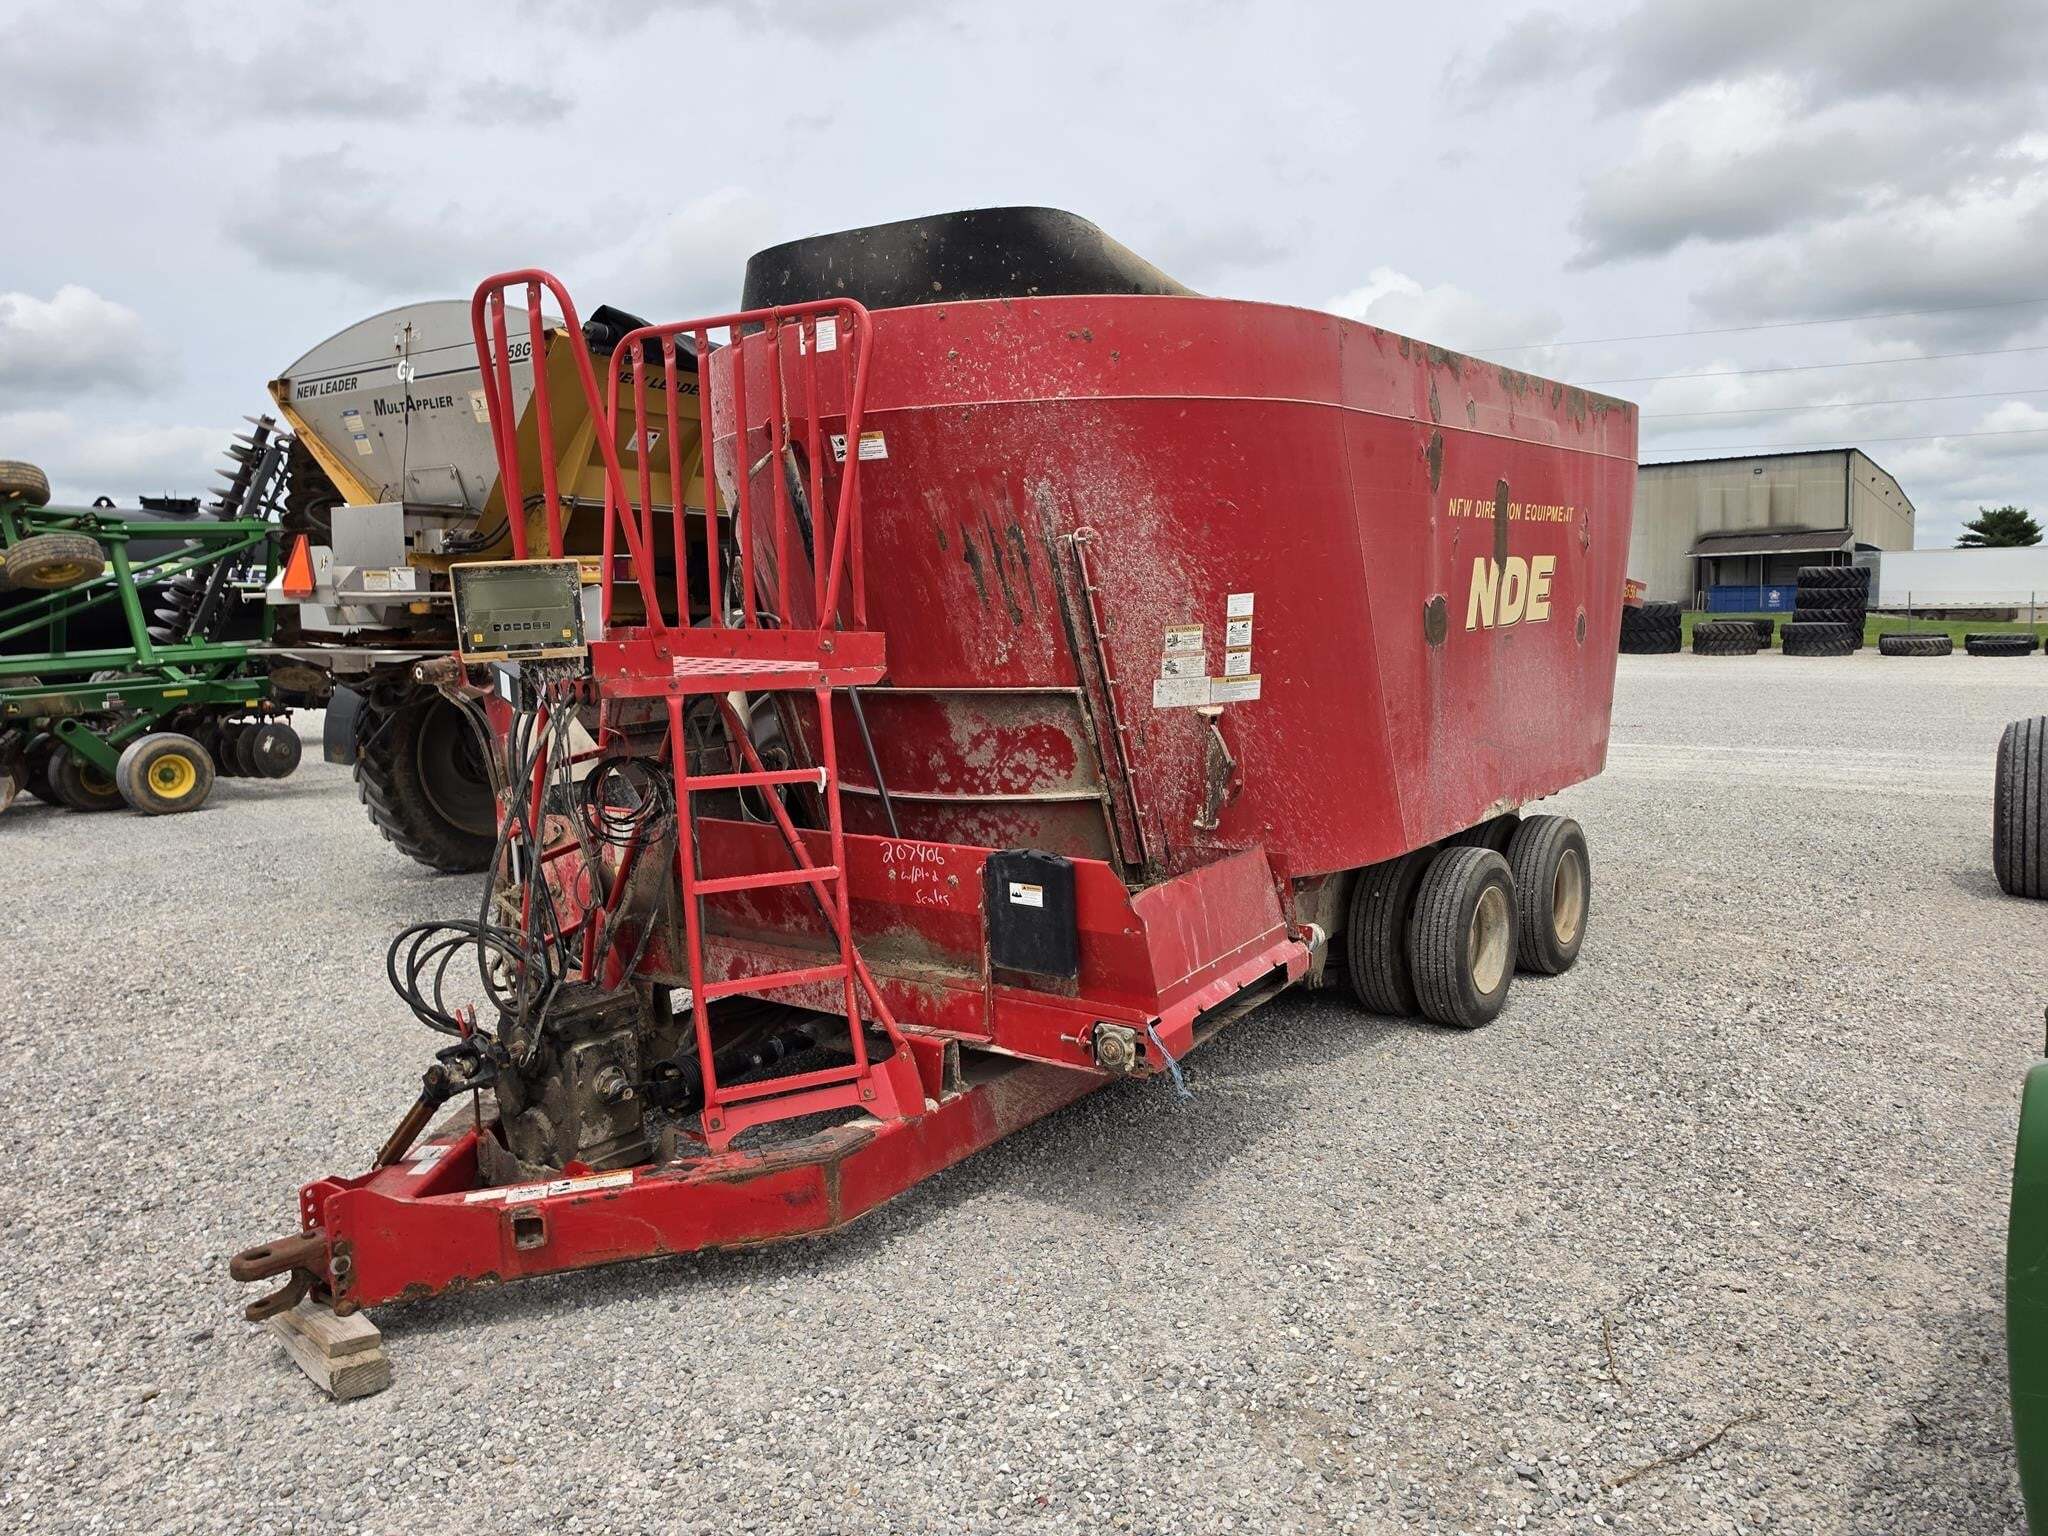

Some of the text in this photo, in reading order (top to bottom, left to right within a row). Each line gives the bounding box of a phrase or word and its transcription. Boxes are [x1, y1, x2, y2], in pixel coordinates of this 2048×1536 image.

[297, 377, 358, 400] NEW LEADER
[648, 375, 701, 396] LEDE
[1475, 500, 1522, 520] DIREION
[1465, 555, 1556, 632] NDE
[879, 841, 945, 865] 207406
